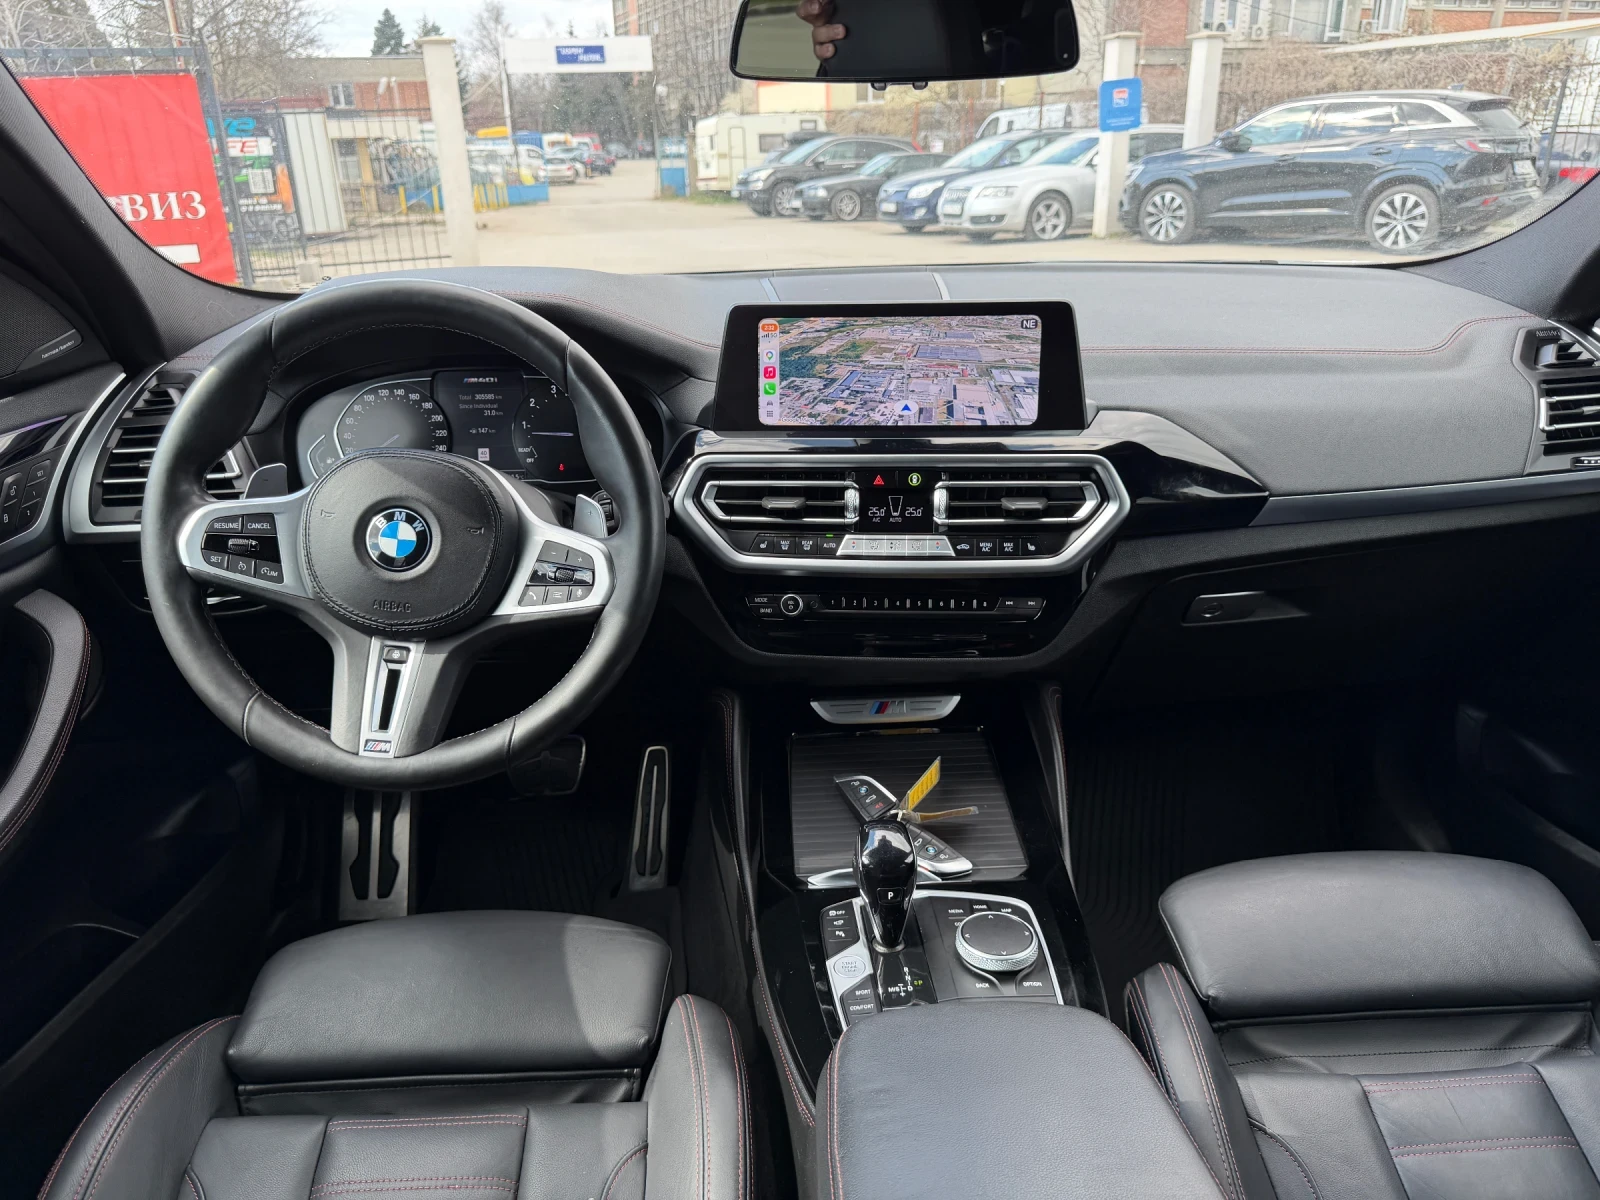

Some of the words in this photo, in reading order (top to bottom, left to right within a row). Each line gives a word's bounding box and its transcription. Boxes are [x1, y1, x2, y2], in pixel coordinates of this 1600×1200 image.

[1023, 319, 1036, 328] NE
[550, 385, 556, 393] 3
[363, 394, 375, 402] 100
[529, 399, 535, 407] 2
[522, 421, 527, 429] 1
[375, 511, 425, 532] BMW
[210, 555, 222, 563] SET
[373, 599, 412, 613] AIRBAG
[888, 891, 894, 899] P
[849, 1003, 874, 1011] COMFORT
